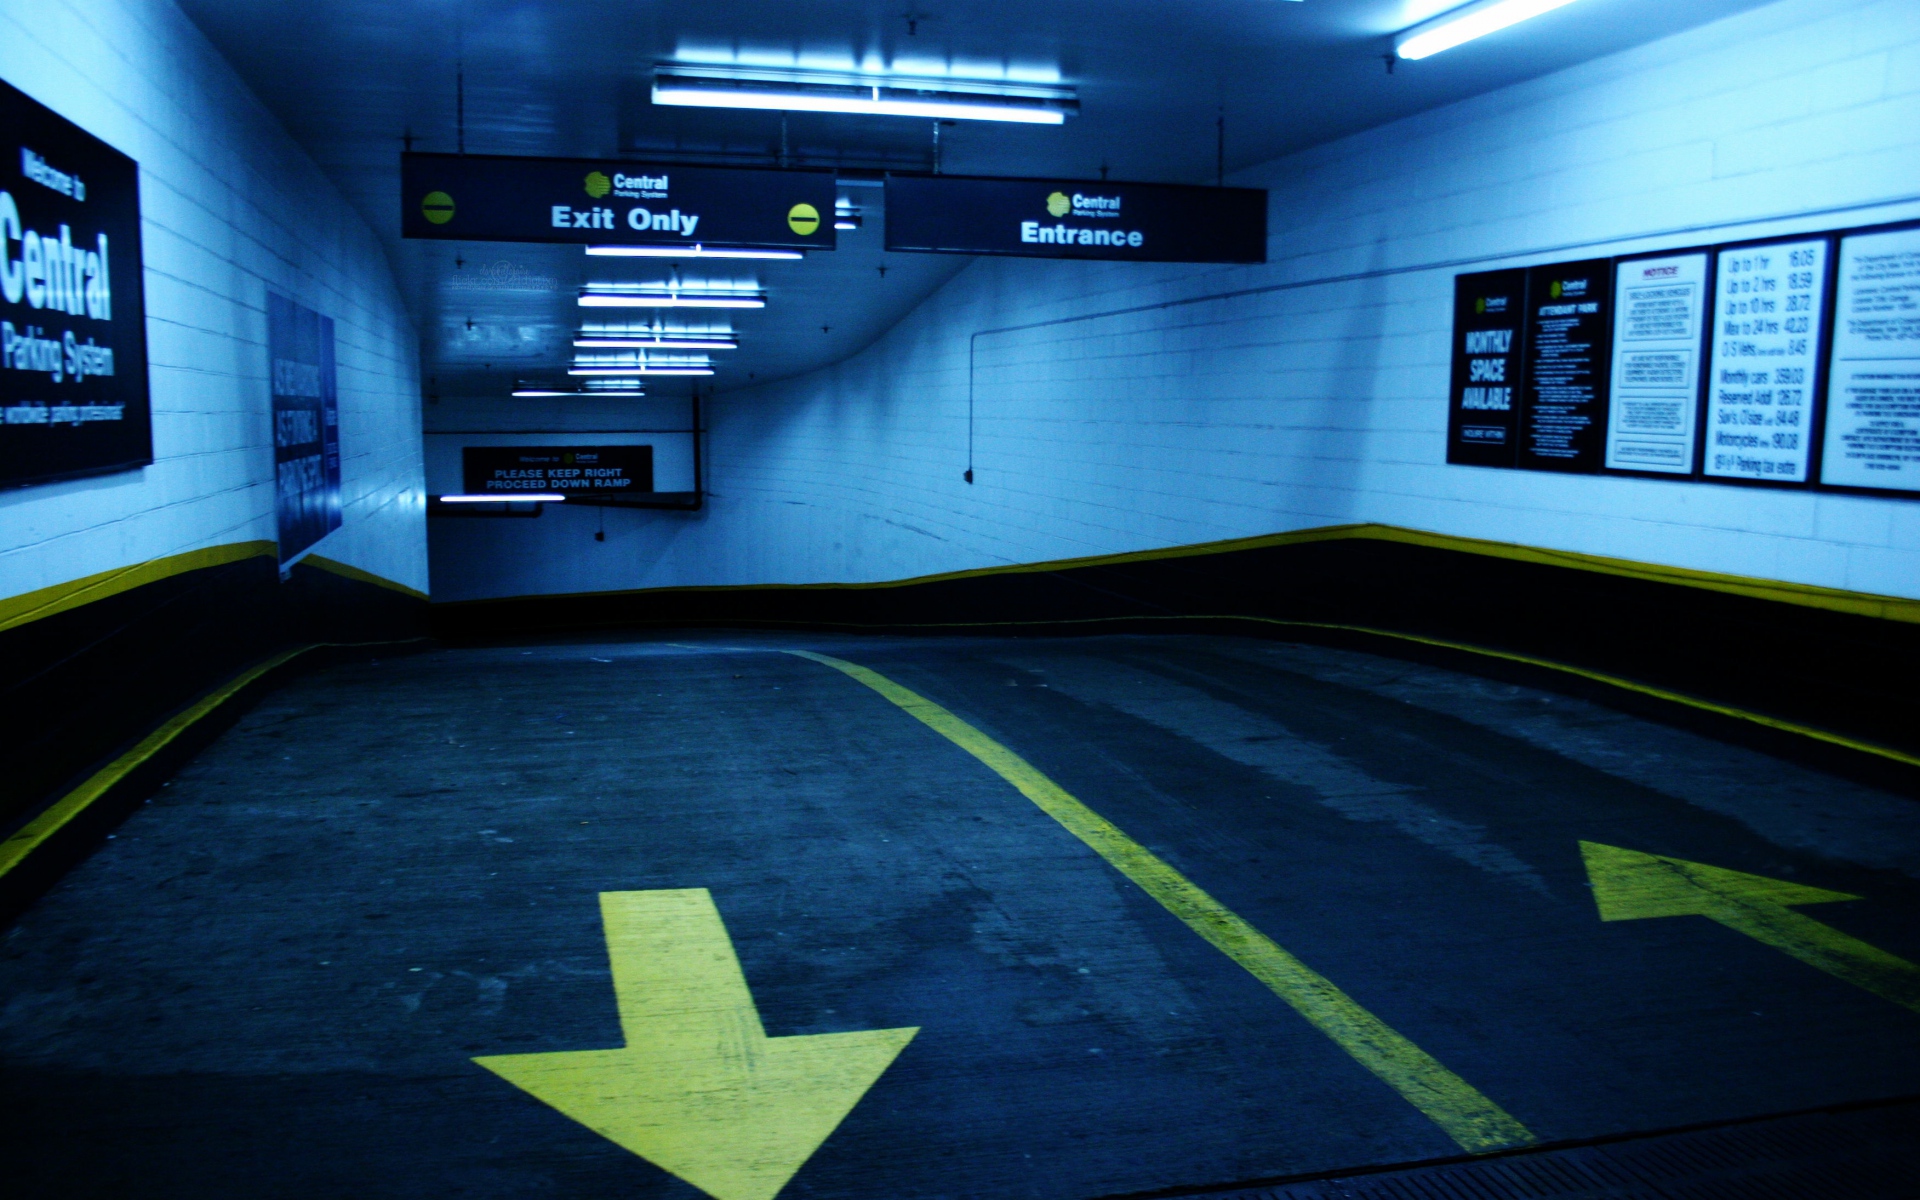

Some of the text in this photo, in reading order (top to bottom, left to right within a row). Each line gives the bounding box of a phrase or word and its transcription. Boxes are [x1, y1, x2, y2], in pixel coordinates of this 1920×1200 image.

[22, 147, 85, 201] Welcome to
[613, 173, 668, 189] Central
[613, 190, 640, 198] Parking
[1072, 194, 1121, 209] Central
[551, 206, 699, 236] Exit Only
[1021, 221, 1143, 247] Entrance
[0, 190, 111, 321] Central
[1728, 258, 1740, 274] Up
[1742, 259, 1751, 272] to
[1760, 255, 1770, 270] hr
[1643, 267, 1679, 277] NOTICE
[1562, 280, 1587, 290] Central
[1726, 279, 1739, 296] Up
[1741, 280, 1750, 293] to
[1753, 277, 1759, 292] 2
[1760, 277, 1776, 292] hrs
[1539, 303, 1598, 316] ATTENDANT PARK
[1725, 301, 1737, 317] Up
[1739, 302, 1748, 314] to
[1749, 298, 1759, 313] 10
[1761, 299, 1775, 313] hrs
[1742, 322, 1751, 335] to
[1752, 320, 1764, 335] 24
[1765, 320, 1779, 335] hrs
[1465, 330, 1513, 354] MONTHLY
[2, 321, 114, 383] Parking System
[1470, 359, 1506, 382] SPACE
[1720, 369, 1748, 387] Monthly
[1751, 373, 1768, 384] cars
[1461, 387, 1512, 410] AVAILABLE
[1719, 389, 1753, 405] Reserved
[1716, 431, 1759, 449] Motorcycles
[495, 469, 622, 478] PLEASE KEEP RIGHT
[1737, 456, 1761, 476] Parking
[1763, 460, 1774, 473] tax
[1777, 461, 1796, 475] extra
[486, 479, 631, 489] PROCEED DOWN RAMP
